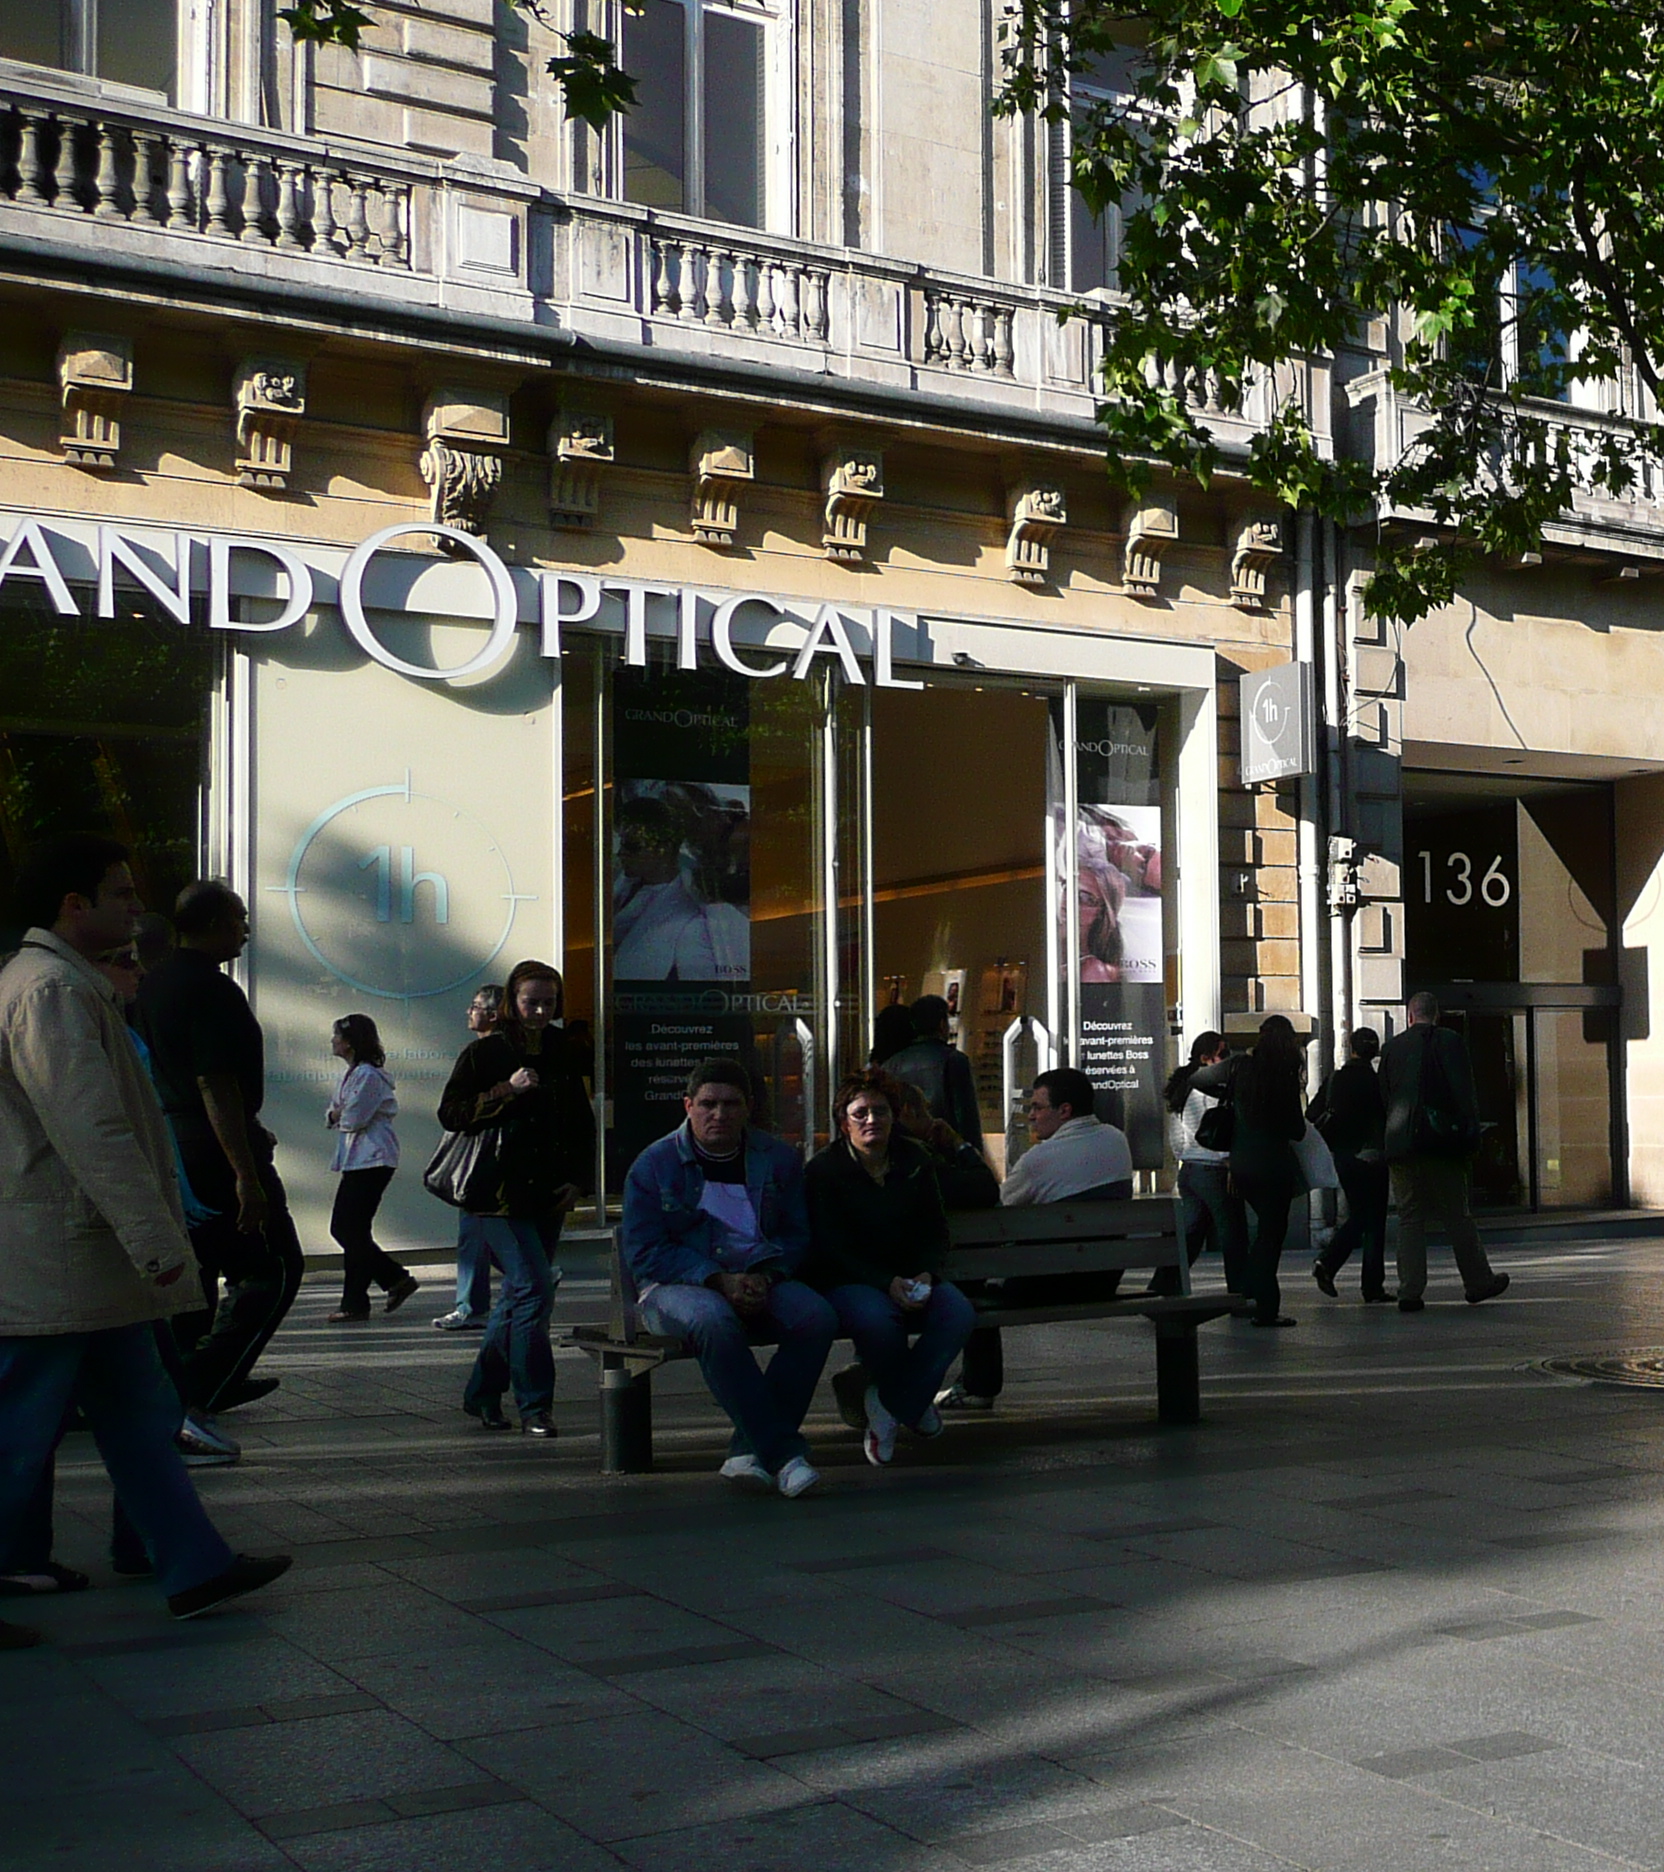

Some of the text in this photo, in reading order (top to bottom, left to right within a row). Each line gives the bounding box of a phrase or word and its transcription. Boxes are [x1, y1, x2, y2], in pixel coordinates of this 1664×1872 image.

[1262, 697, 1279, 724] 1h
[1058, 739, 1149, 757] GANDOPTICAL
[356, 844, 450, 925] 1h
[1418, 850, 1511, 908] 136
[1120, 958, 1157, 969] BOSS
[651, 1023, 714, 1035] Découvrez
[1083, 1020, 1133, 1031] Découvrez
[1086, 1050, 1124, 1060] lunettes
[1125, 1050, 1149, 1060] Boss
[1083, 1065, 1127, 1075] éservées
[1091, 1079, 1140, 1091] andOptical
